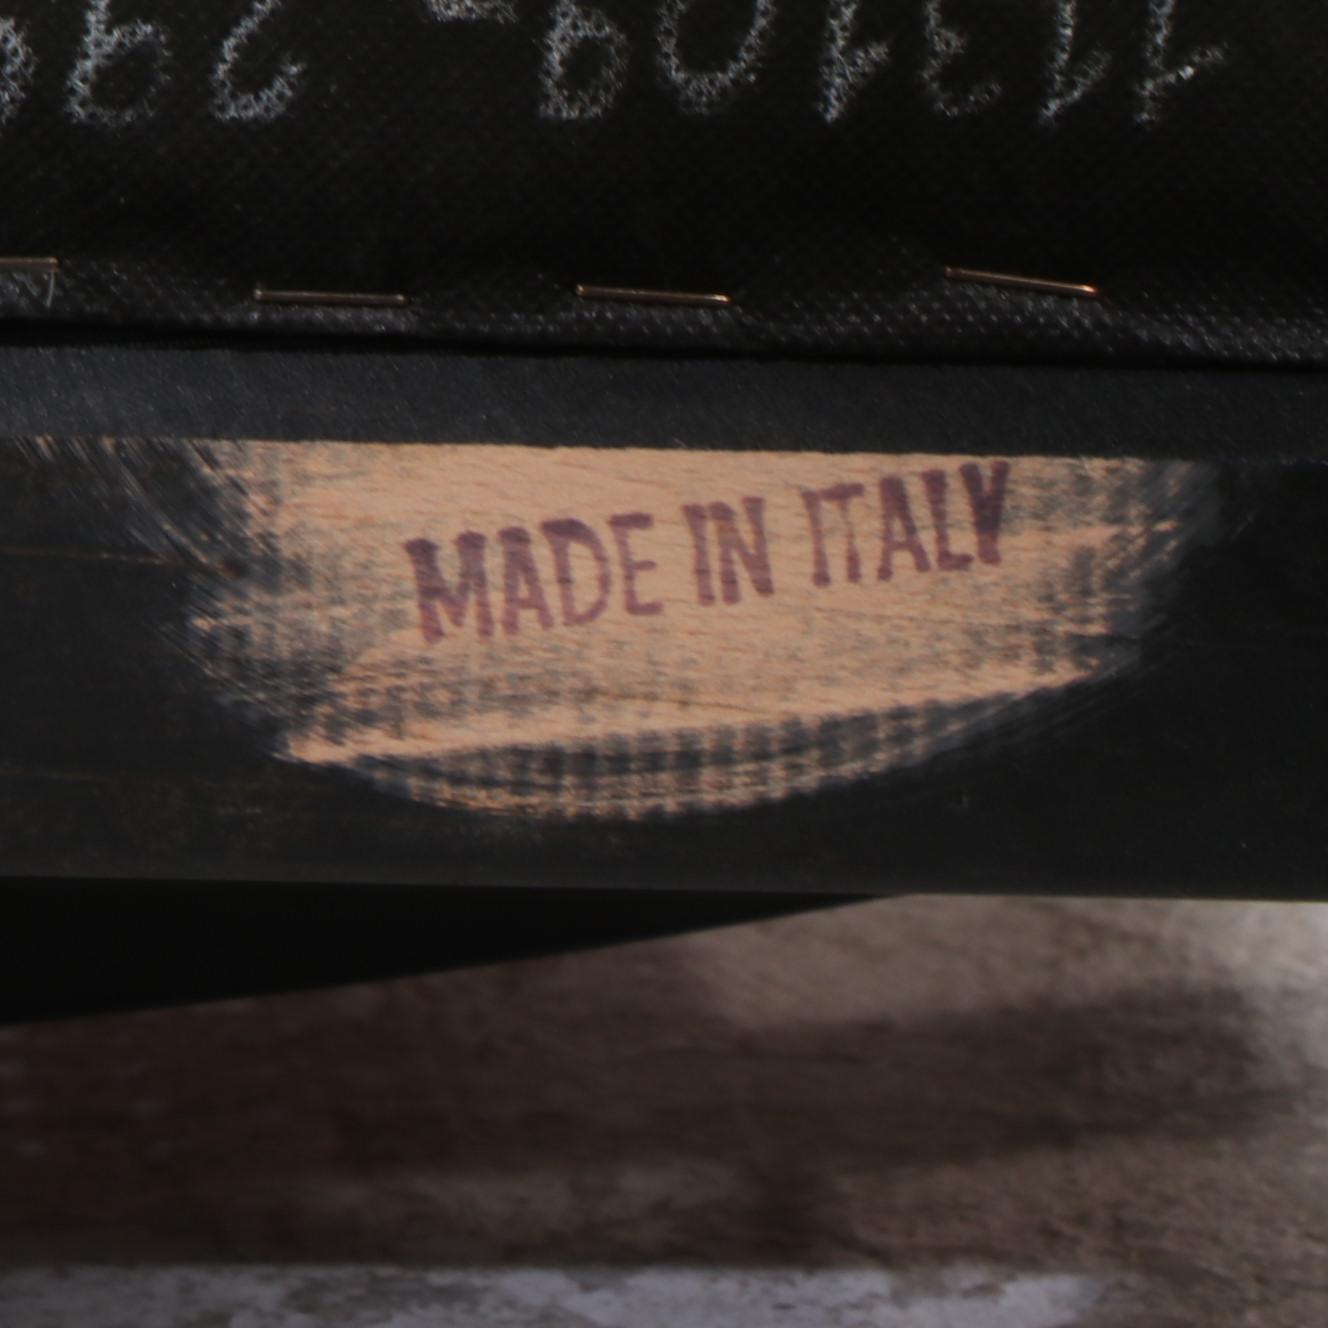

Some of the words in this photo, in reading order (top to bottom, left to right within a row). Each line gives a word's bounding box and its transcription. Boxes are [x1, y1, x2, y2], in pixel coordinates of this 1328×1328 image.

[404, 512, 664, 644] MADE
[682, 497, 774, 607] IN
[801, 459, 1011, 588] ITALY
